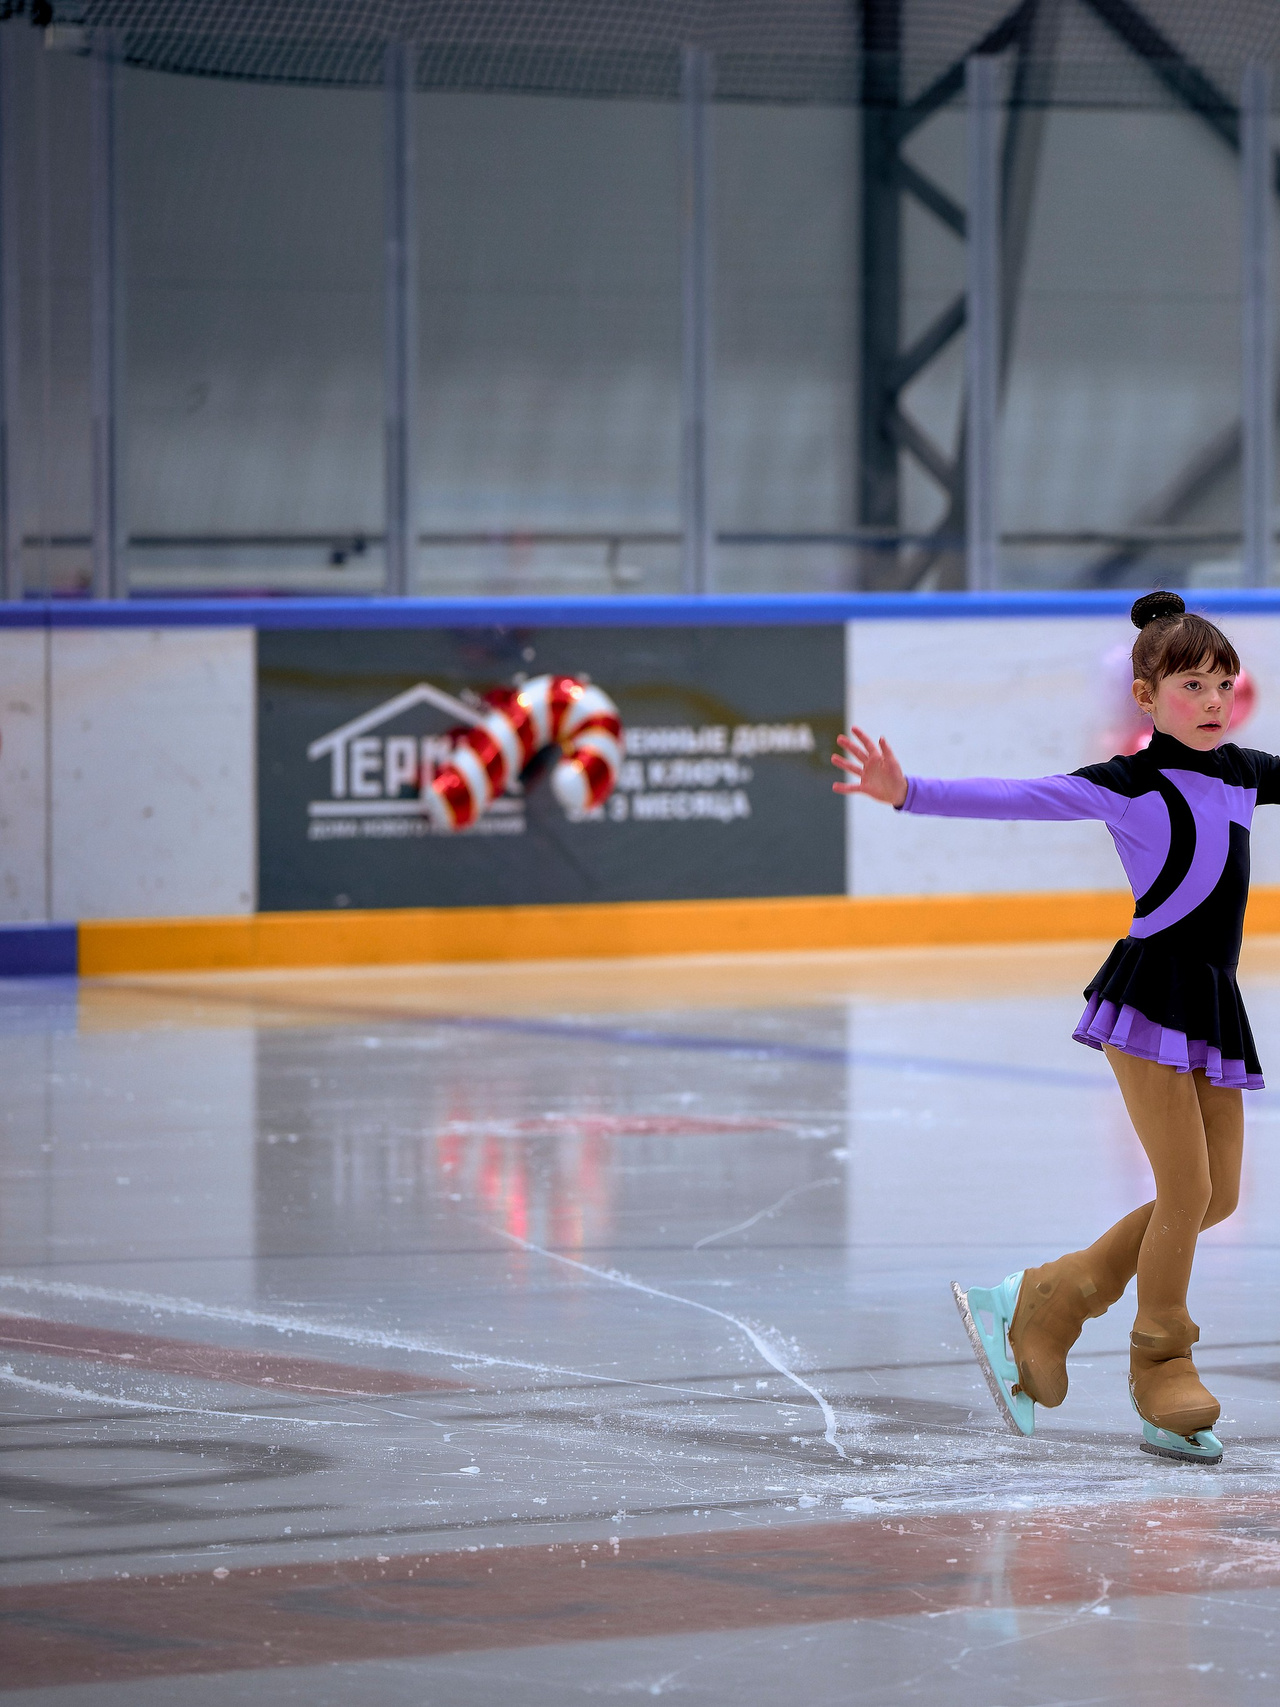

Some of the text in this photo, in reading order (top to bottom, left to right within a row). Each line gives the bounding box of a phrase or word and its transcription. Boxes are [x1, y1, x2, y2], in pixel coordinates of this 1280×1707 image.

[625, 723, 815, 757] ЕННЫЕ ДОМА
[308, 733, 524, 798] ТЕРМ
[632, 790, 752, 823] МЕСЯЦА
